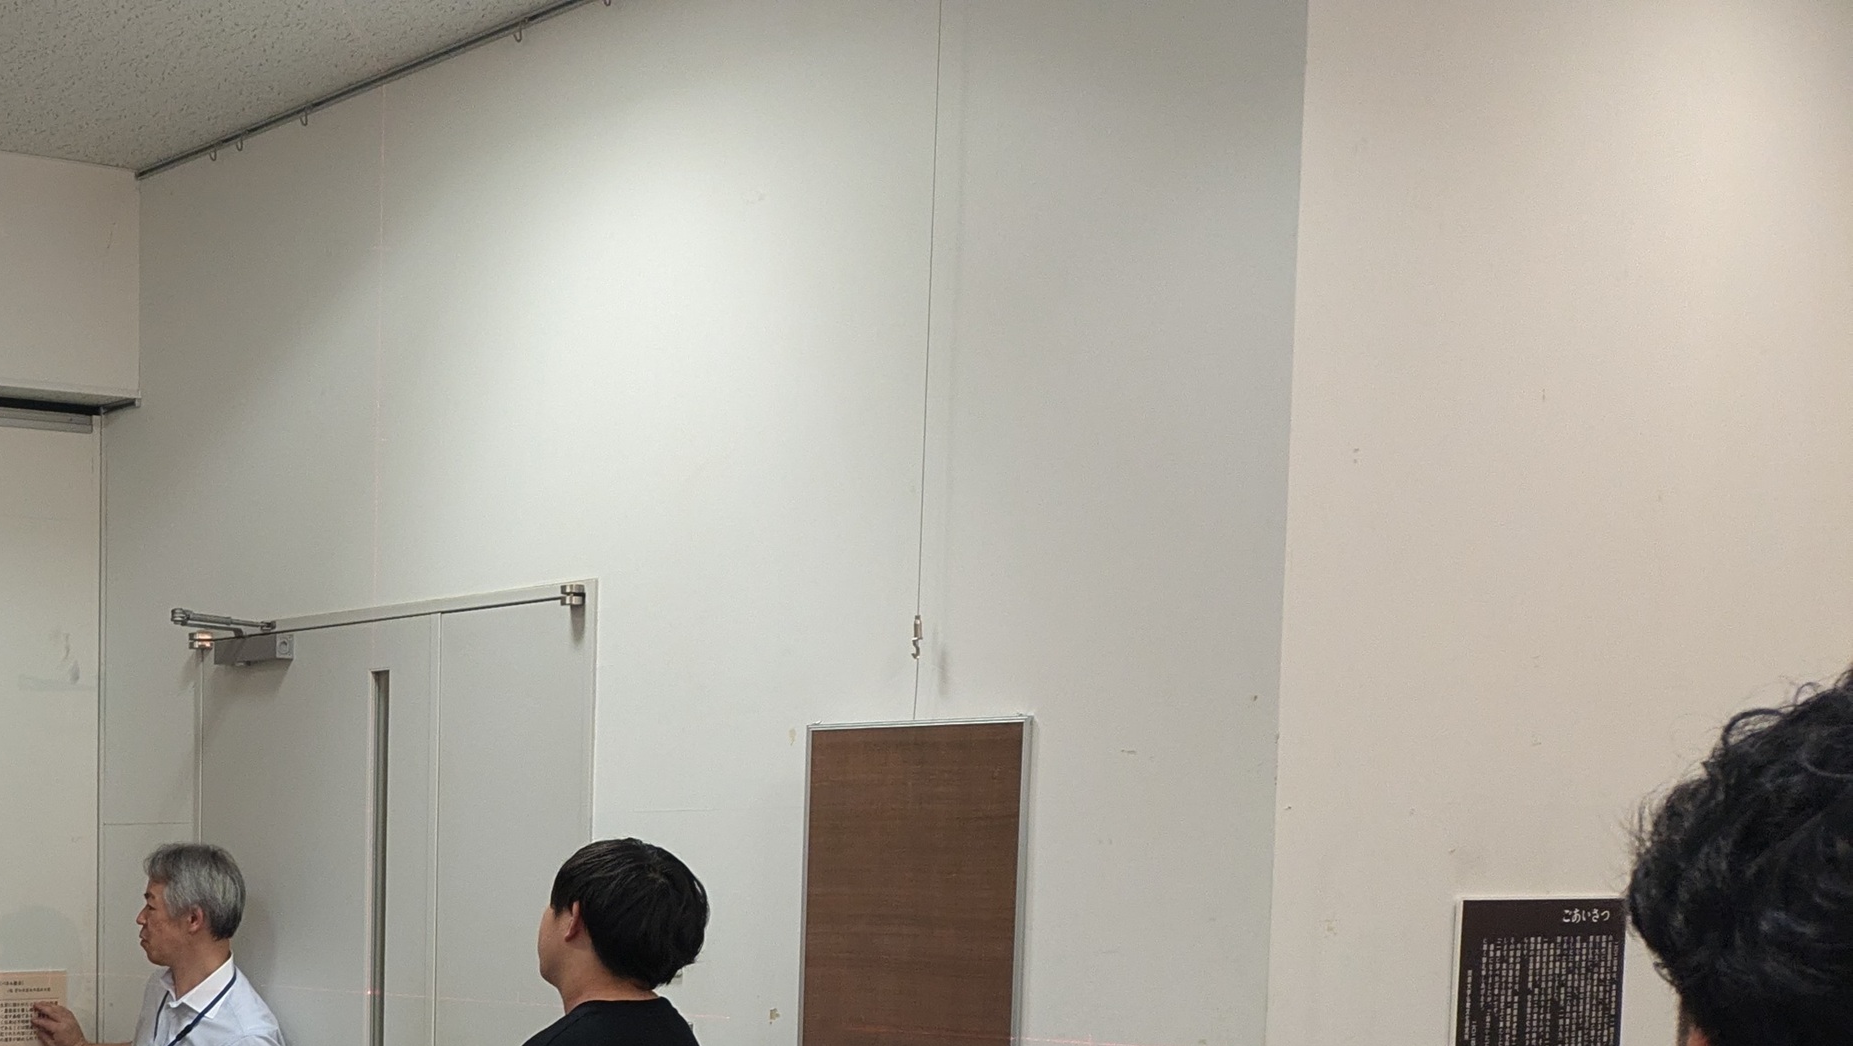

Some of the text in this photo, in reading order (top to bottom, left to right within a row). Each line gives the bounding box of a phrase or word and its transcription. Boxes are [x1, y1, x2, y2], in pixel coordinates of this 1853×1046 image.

[1562, 908, 1610, 923] ごあいさつ
